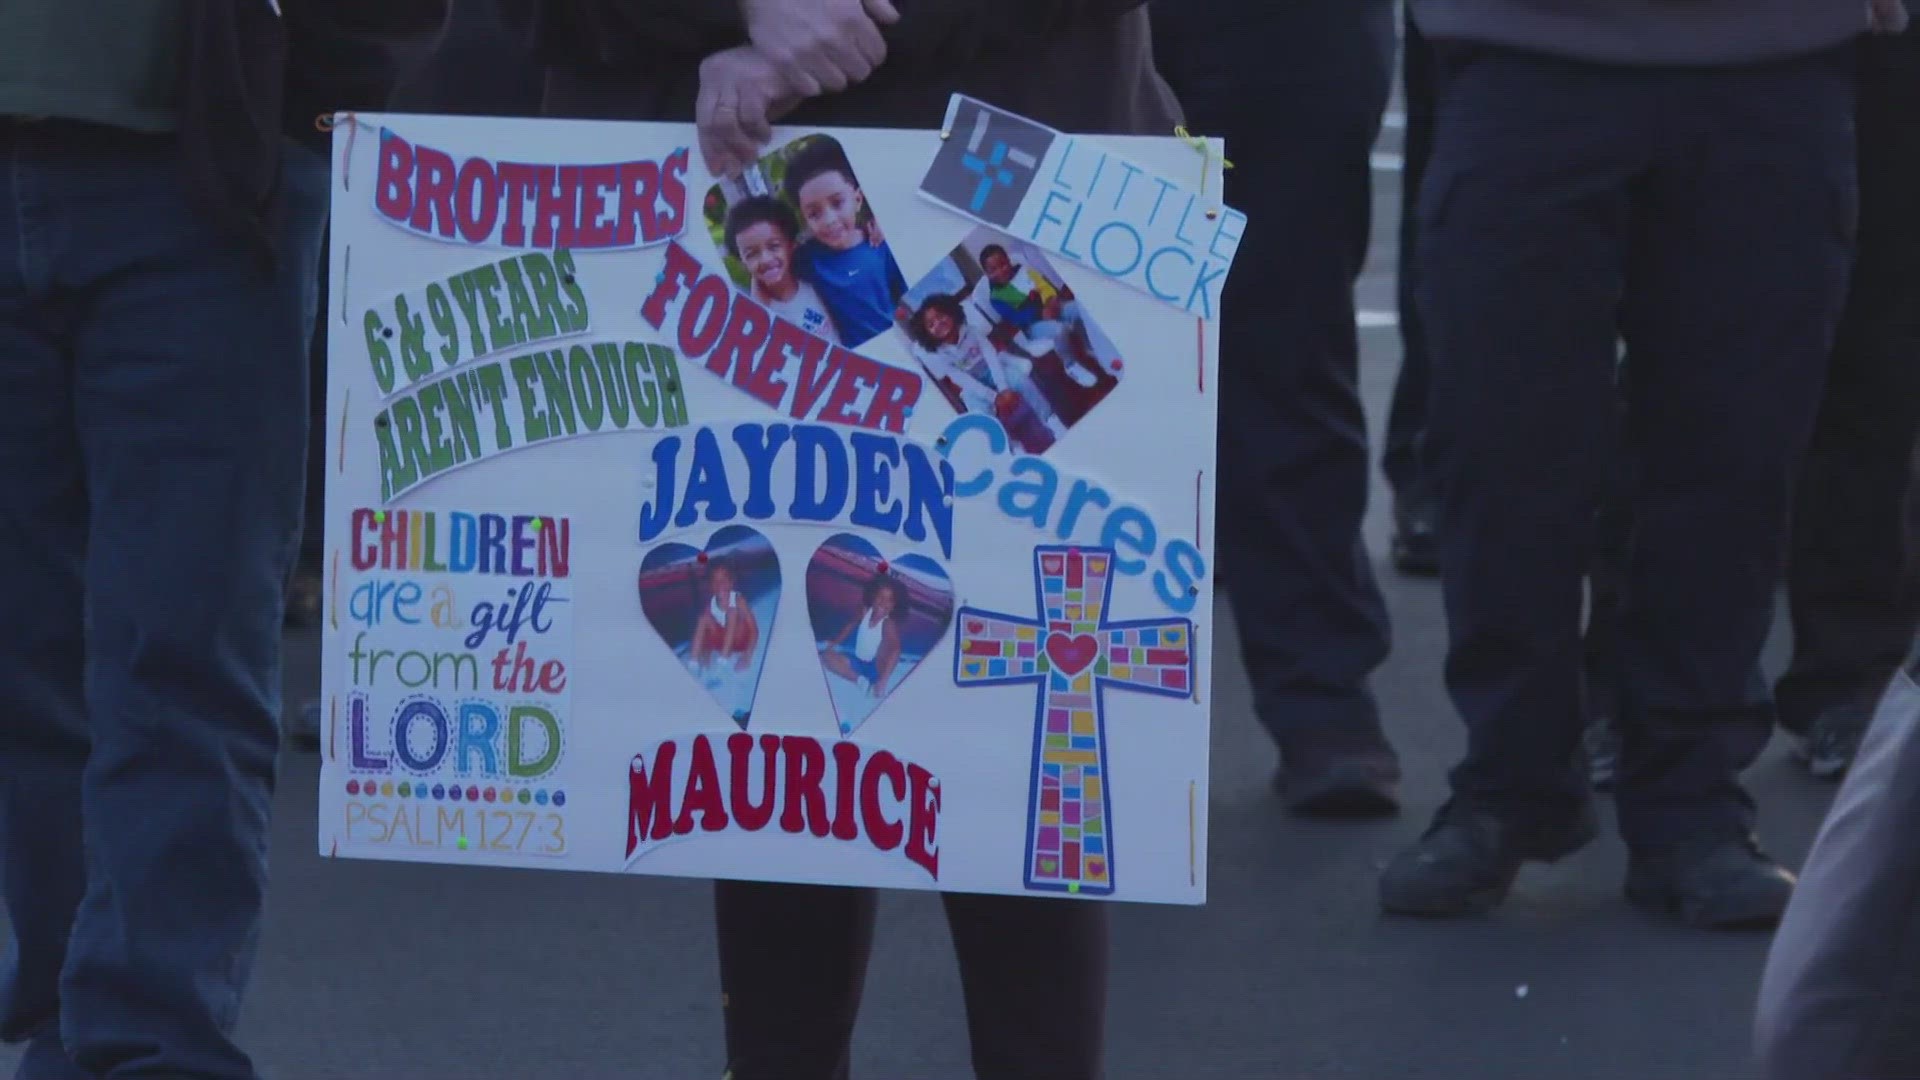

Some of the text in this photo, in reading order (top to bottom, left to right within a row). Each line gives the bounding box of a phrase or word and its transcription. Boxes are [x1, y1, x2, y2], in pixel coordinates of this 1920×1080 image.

[376, 126, 689, 248] BROTHERS
[1053, 138, 1246, 262] LITTLE
[1031, 191, 1225, 320] FLOCK
[363, 248, 590, 394] 6 & 9 YEARS
[641, 239, 923, 434] FOREVER
[374, 341, 690, 506] AREN'T ENOUGH
[351, 508, 570, 578] CHILDREN
[639, 422, 955, 560] JAYDEN
[935, 413, 1205, 614] Cares
[348, 631, 567, 694] from the
[350, 579, 570, 650] are a gift
[347, 692, 566, 784] LORD
[345, 801, 466, 849] PSALM
[625, 732, 941, 882] MAURICE
